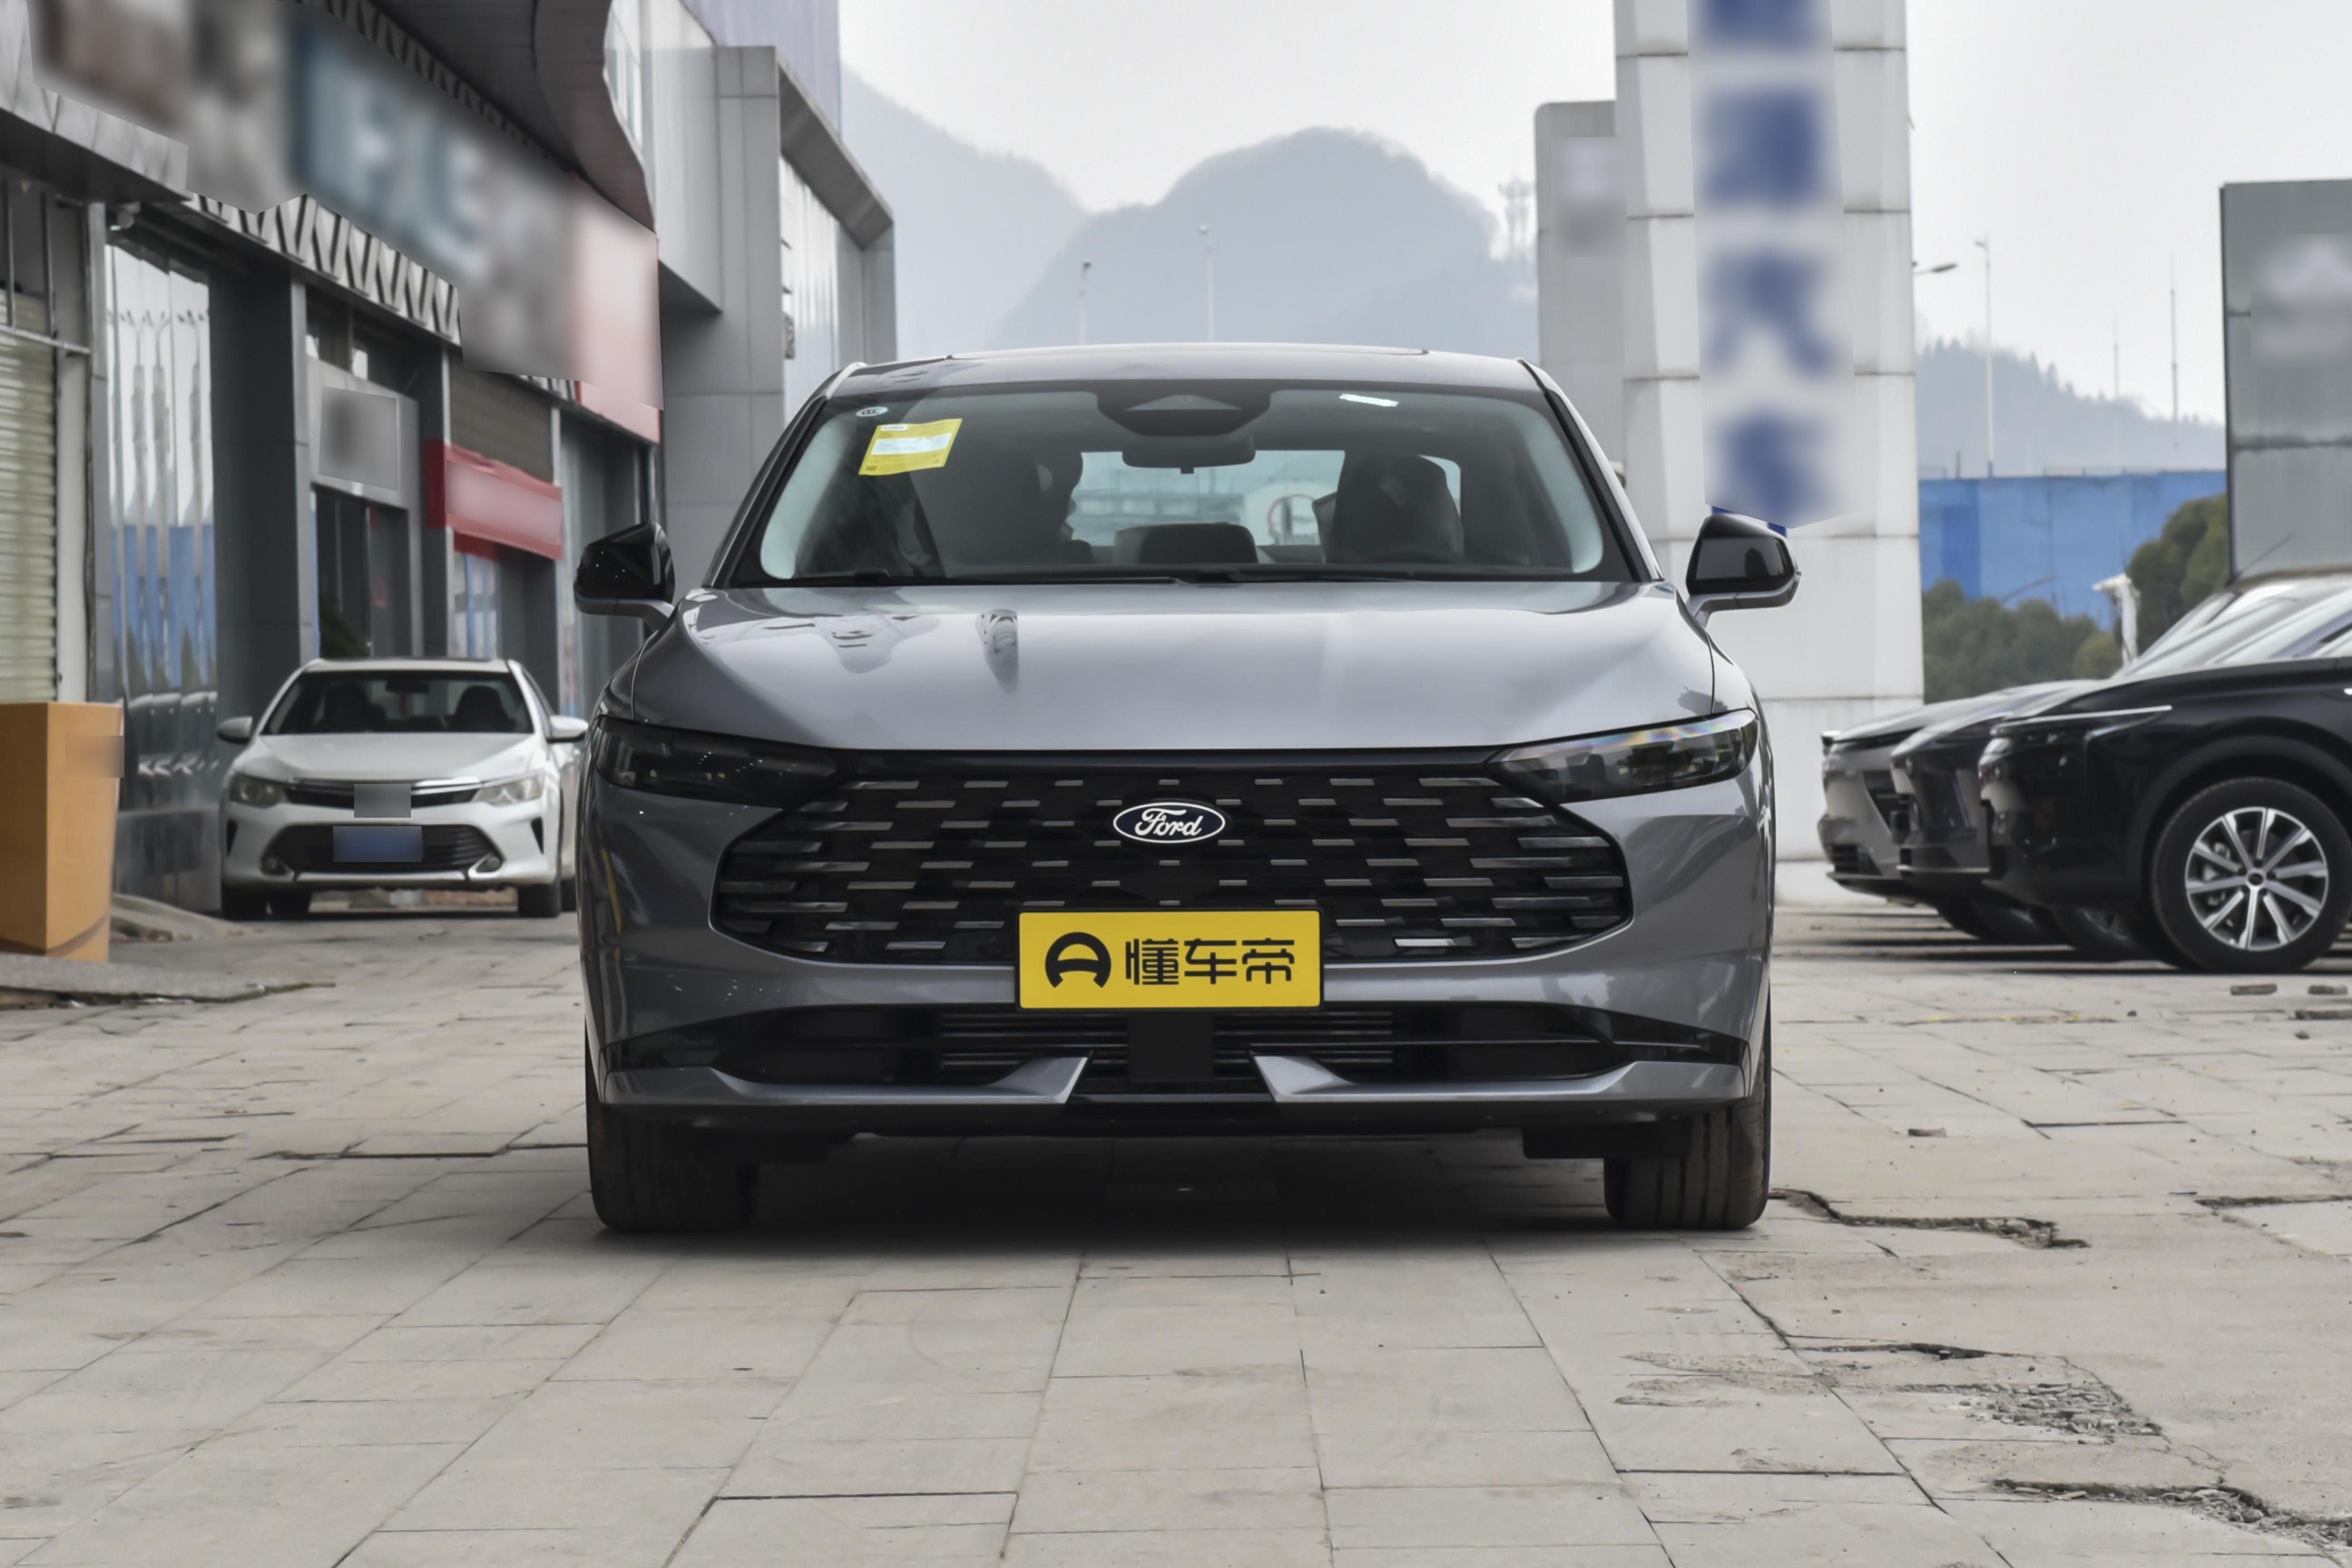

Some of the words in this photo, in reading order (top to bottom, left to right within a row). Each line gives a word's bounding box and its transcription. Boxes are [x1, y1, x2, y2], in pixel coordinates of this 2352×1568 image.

[1134, 808, 1204, 836] Ford
[1125, 938, 1295, 985] 懂车帝
